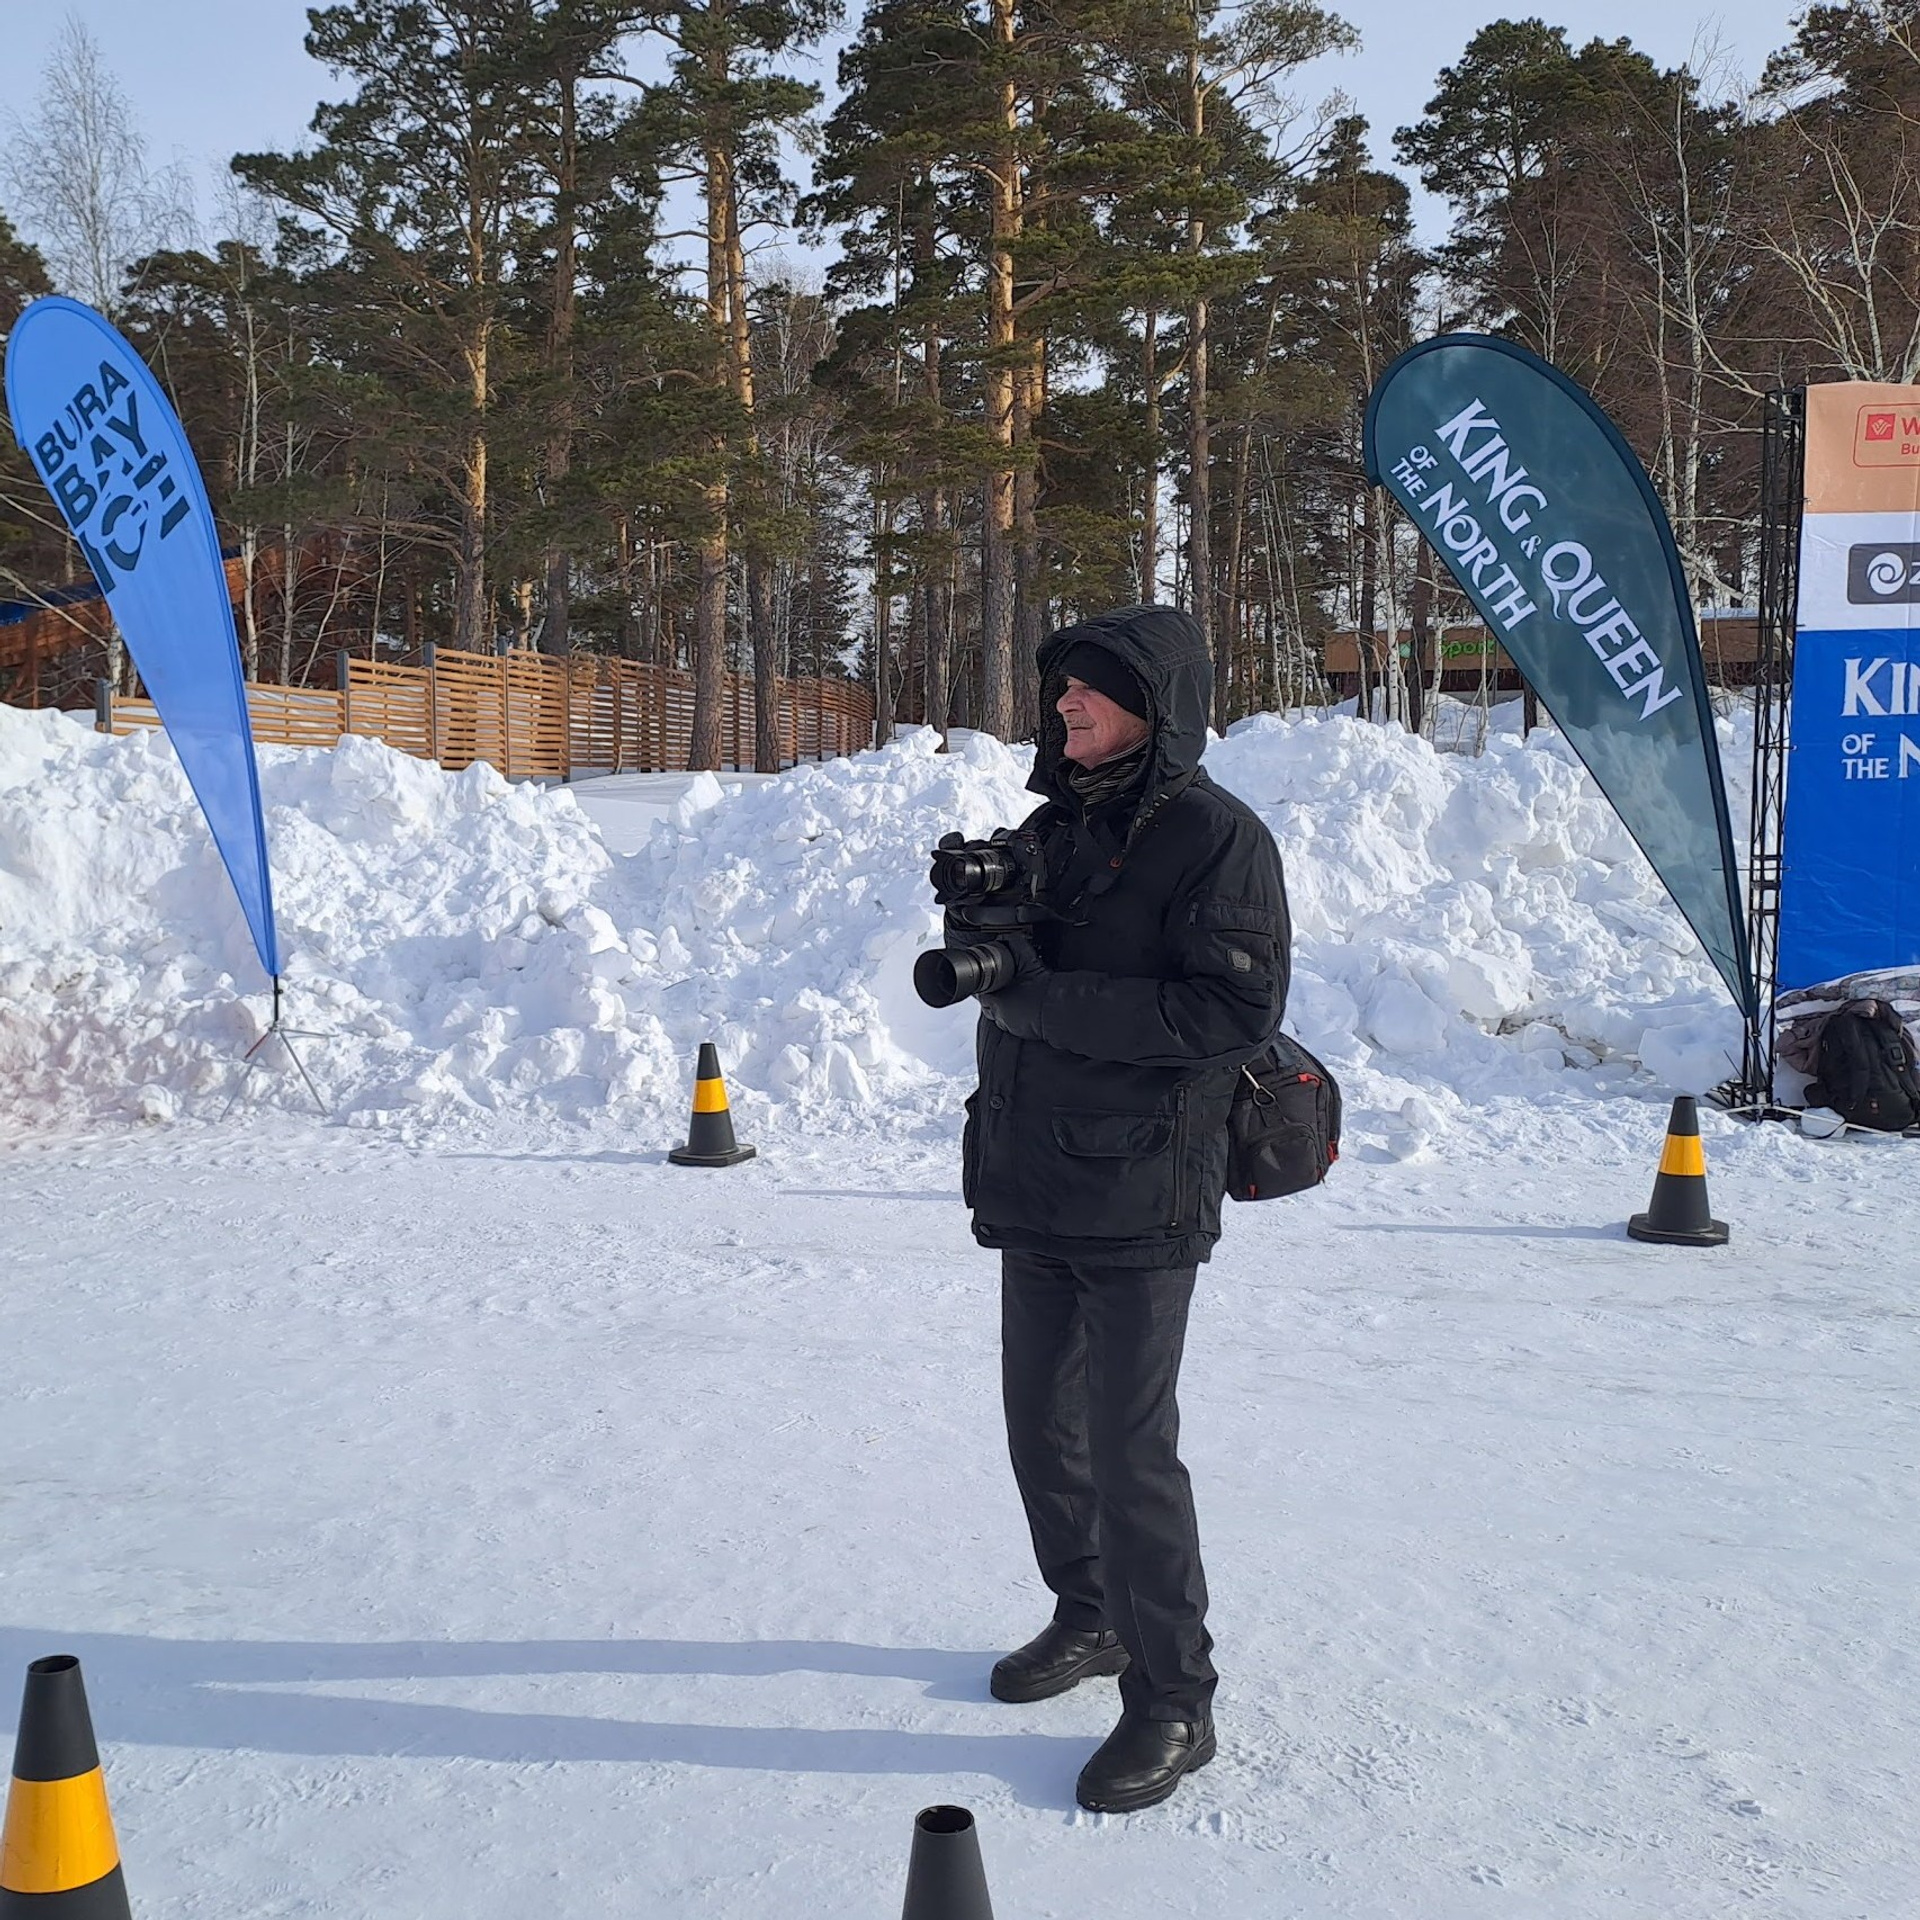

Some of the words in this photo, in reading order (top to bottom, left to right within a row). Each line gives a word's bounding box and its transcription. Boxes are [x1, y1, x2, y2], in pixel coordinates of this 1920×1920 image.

[34, 360, 130, 476] BURA
[53, 390, 148, 529] BAY
[1390, 457, 1428, 499] THE
[1409, 445, 1439, 472] OF
[1418, 482, 1538, 632] NORTH
[1434, 397, 1548, 535] KING
[1521, 534, 1541, 560] &
[1541, 540, 1684, 722] QUEEN
[1842, 734, 1876, 755] OF
[1842, 757, 1889, 780] THE
